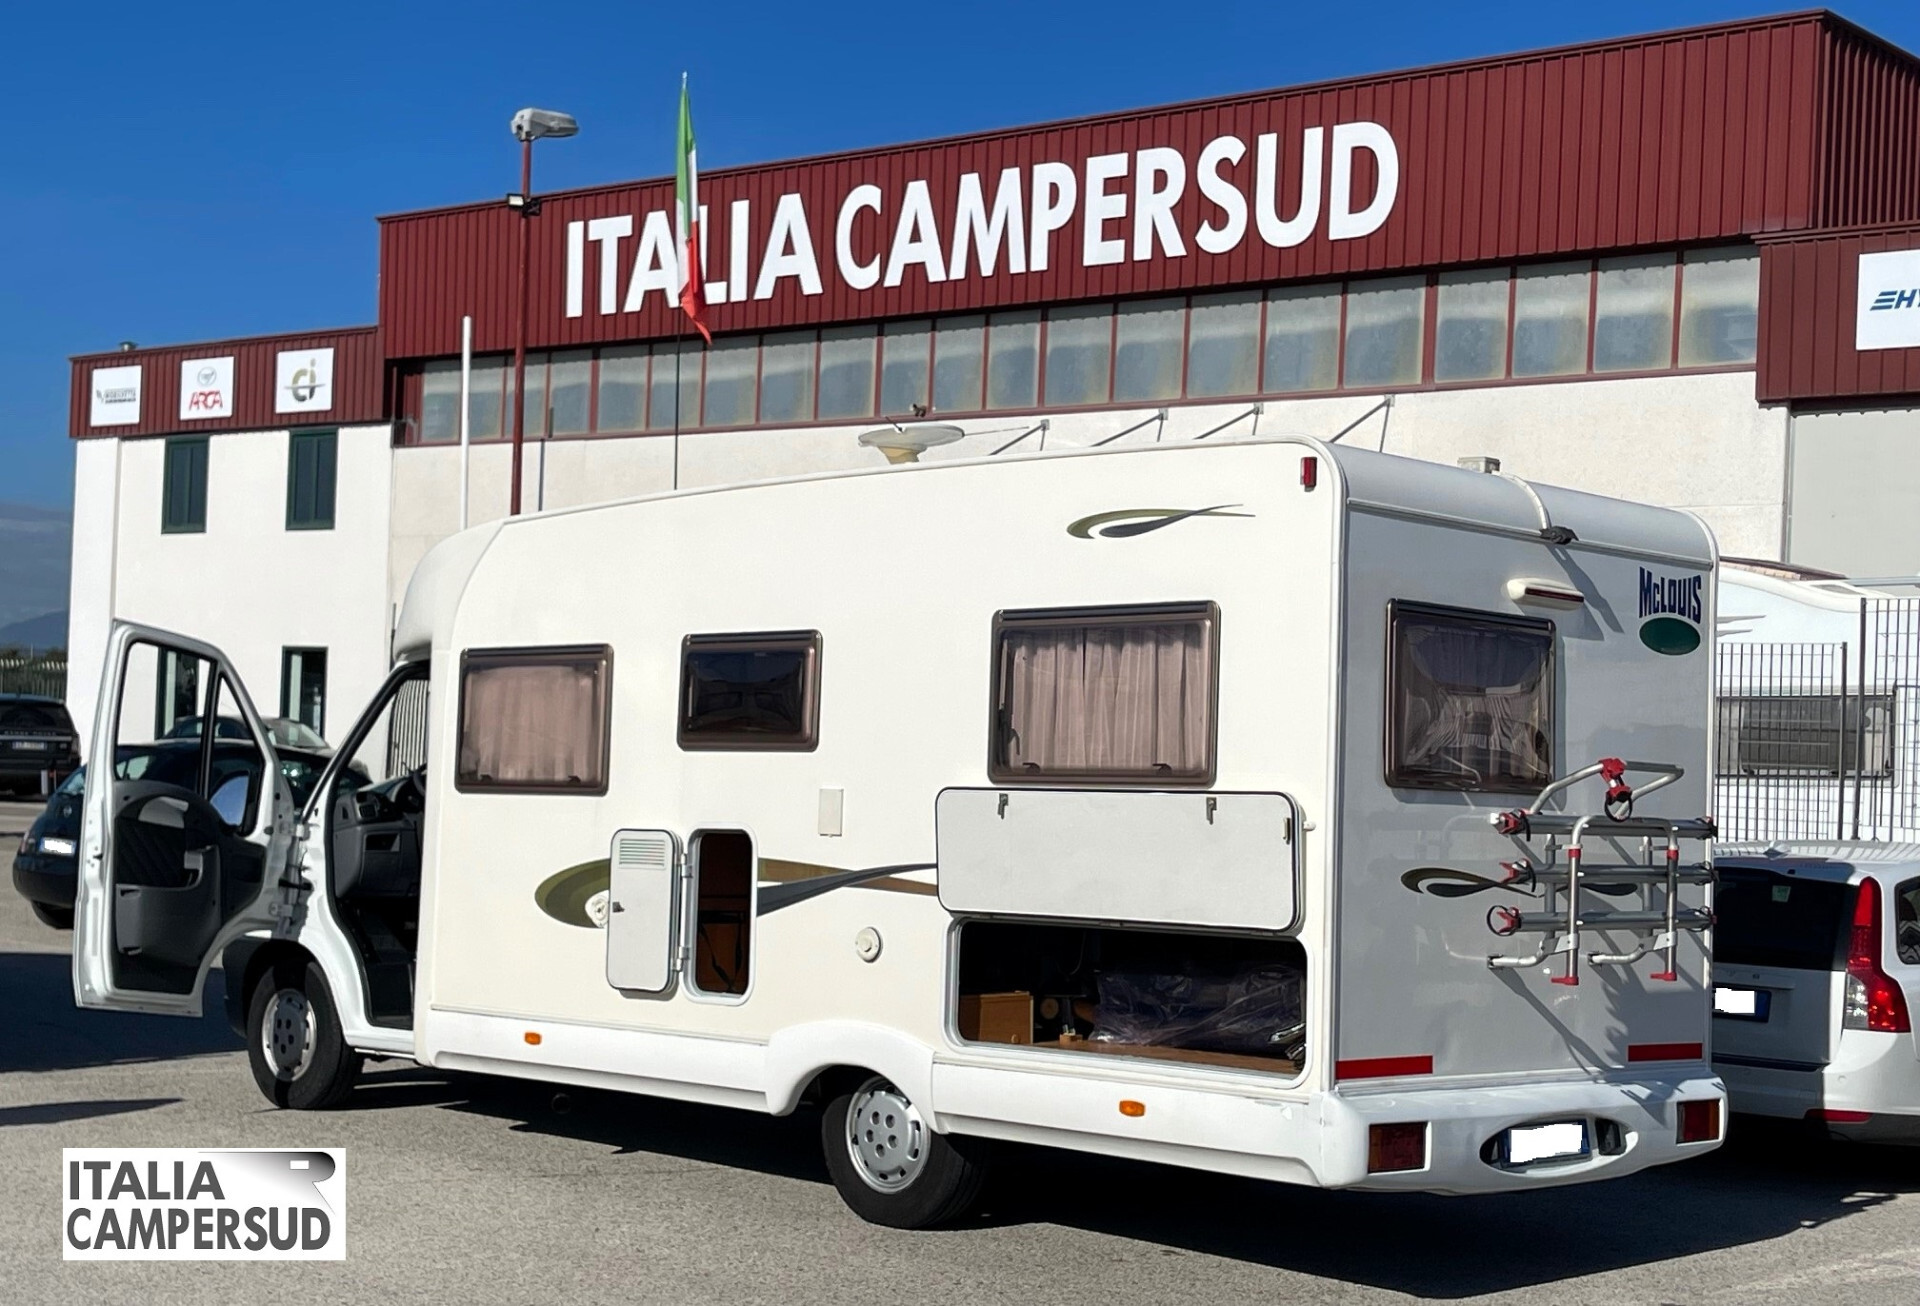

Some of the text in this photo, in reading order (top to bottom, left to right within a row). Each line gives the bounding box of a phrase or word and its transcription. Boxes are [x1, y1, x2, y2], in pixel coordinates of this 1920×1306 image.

[566, 121, 1399, 318] ITALIA CAMPERSUD
[188, 390, 223, 411] ARCA
